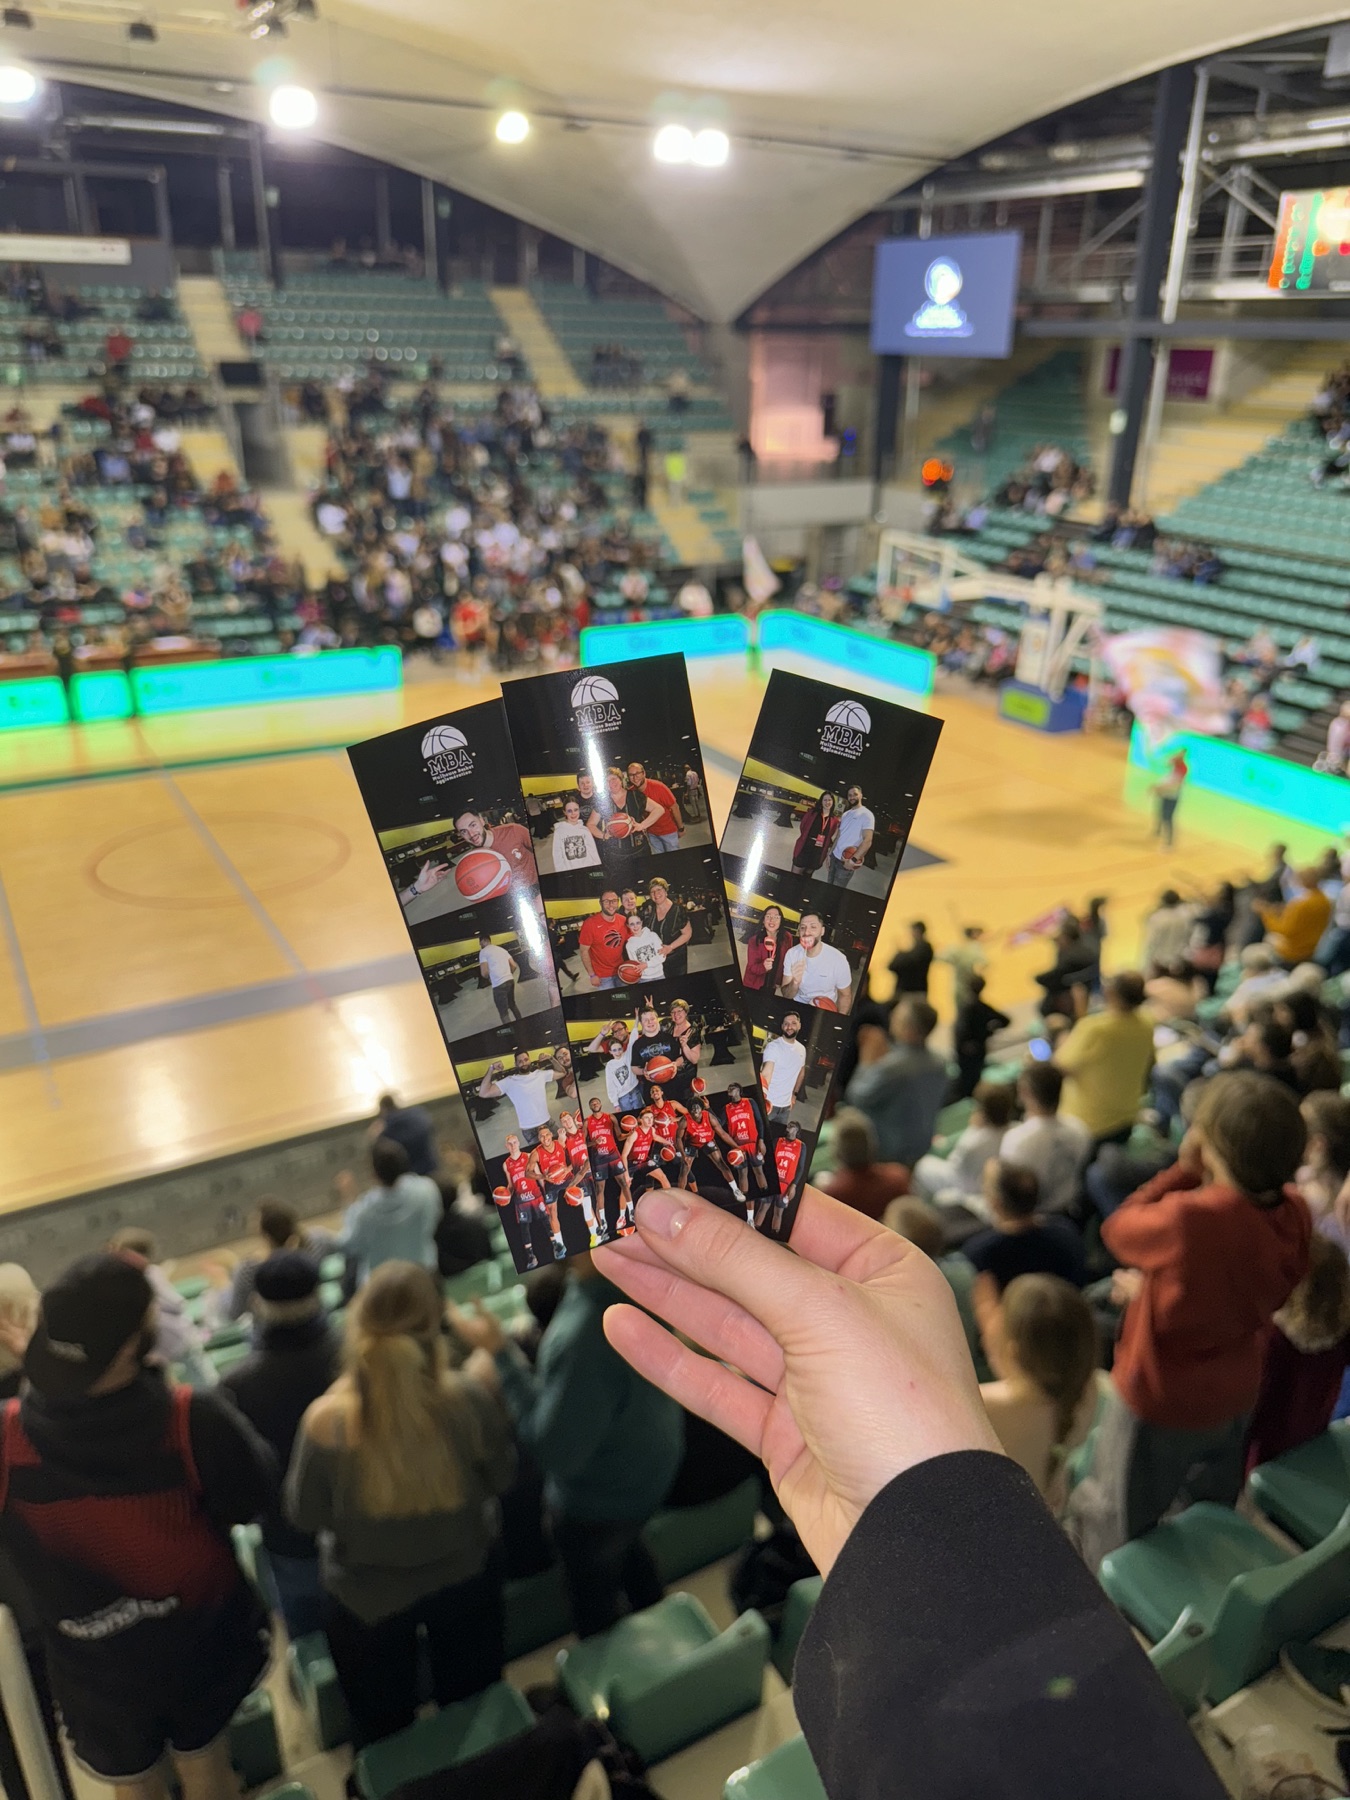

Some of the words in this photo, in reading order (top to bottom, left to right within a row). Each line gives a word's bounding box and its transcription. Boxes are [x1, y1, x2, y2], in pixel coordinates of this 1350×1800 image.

[575, 703, 621, 727] MBA
[821, 725, 863, 752] MBA
[427, 749, 473, 776] MBA
[737, 1121, 747, 1130] 14
[779, 1159, 789, 1168] 14
[520, 1180, 528, 1190] 2
